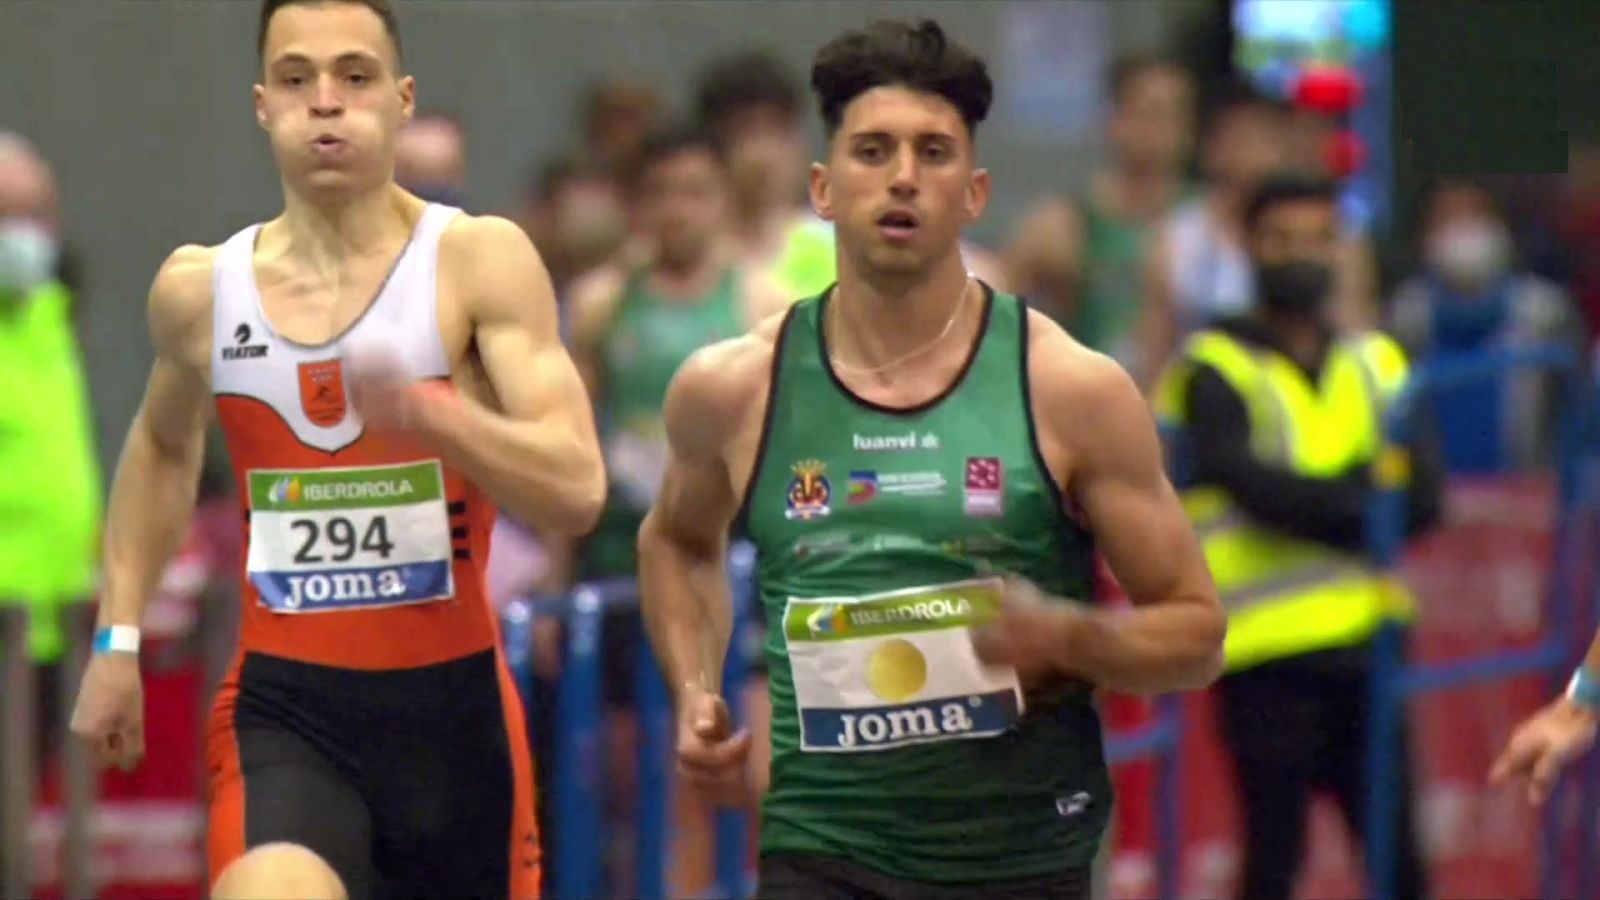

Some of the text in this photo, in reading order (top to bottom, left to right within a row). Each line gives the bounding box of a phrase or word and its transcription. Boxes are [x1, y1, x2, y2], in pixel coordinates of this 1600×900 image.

[304, 480, 413, 501] IBERDROLA
[291, 516, 394, 564] 294
[851, 599, 972, 625] IBERDROLA
